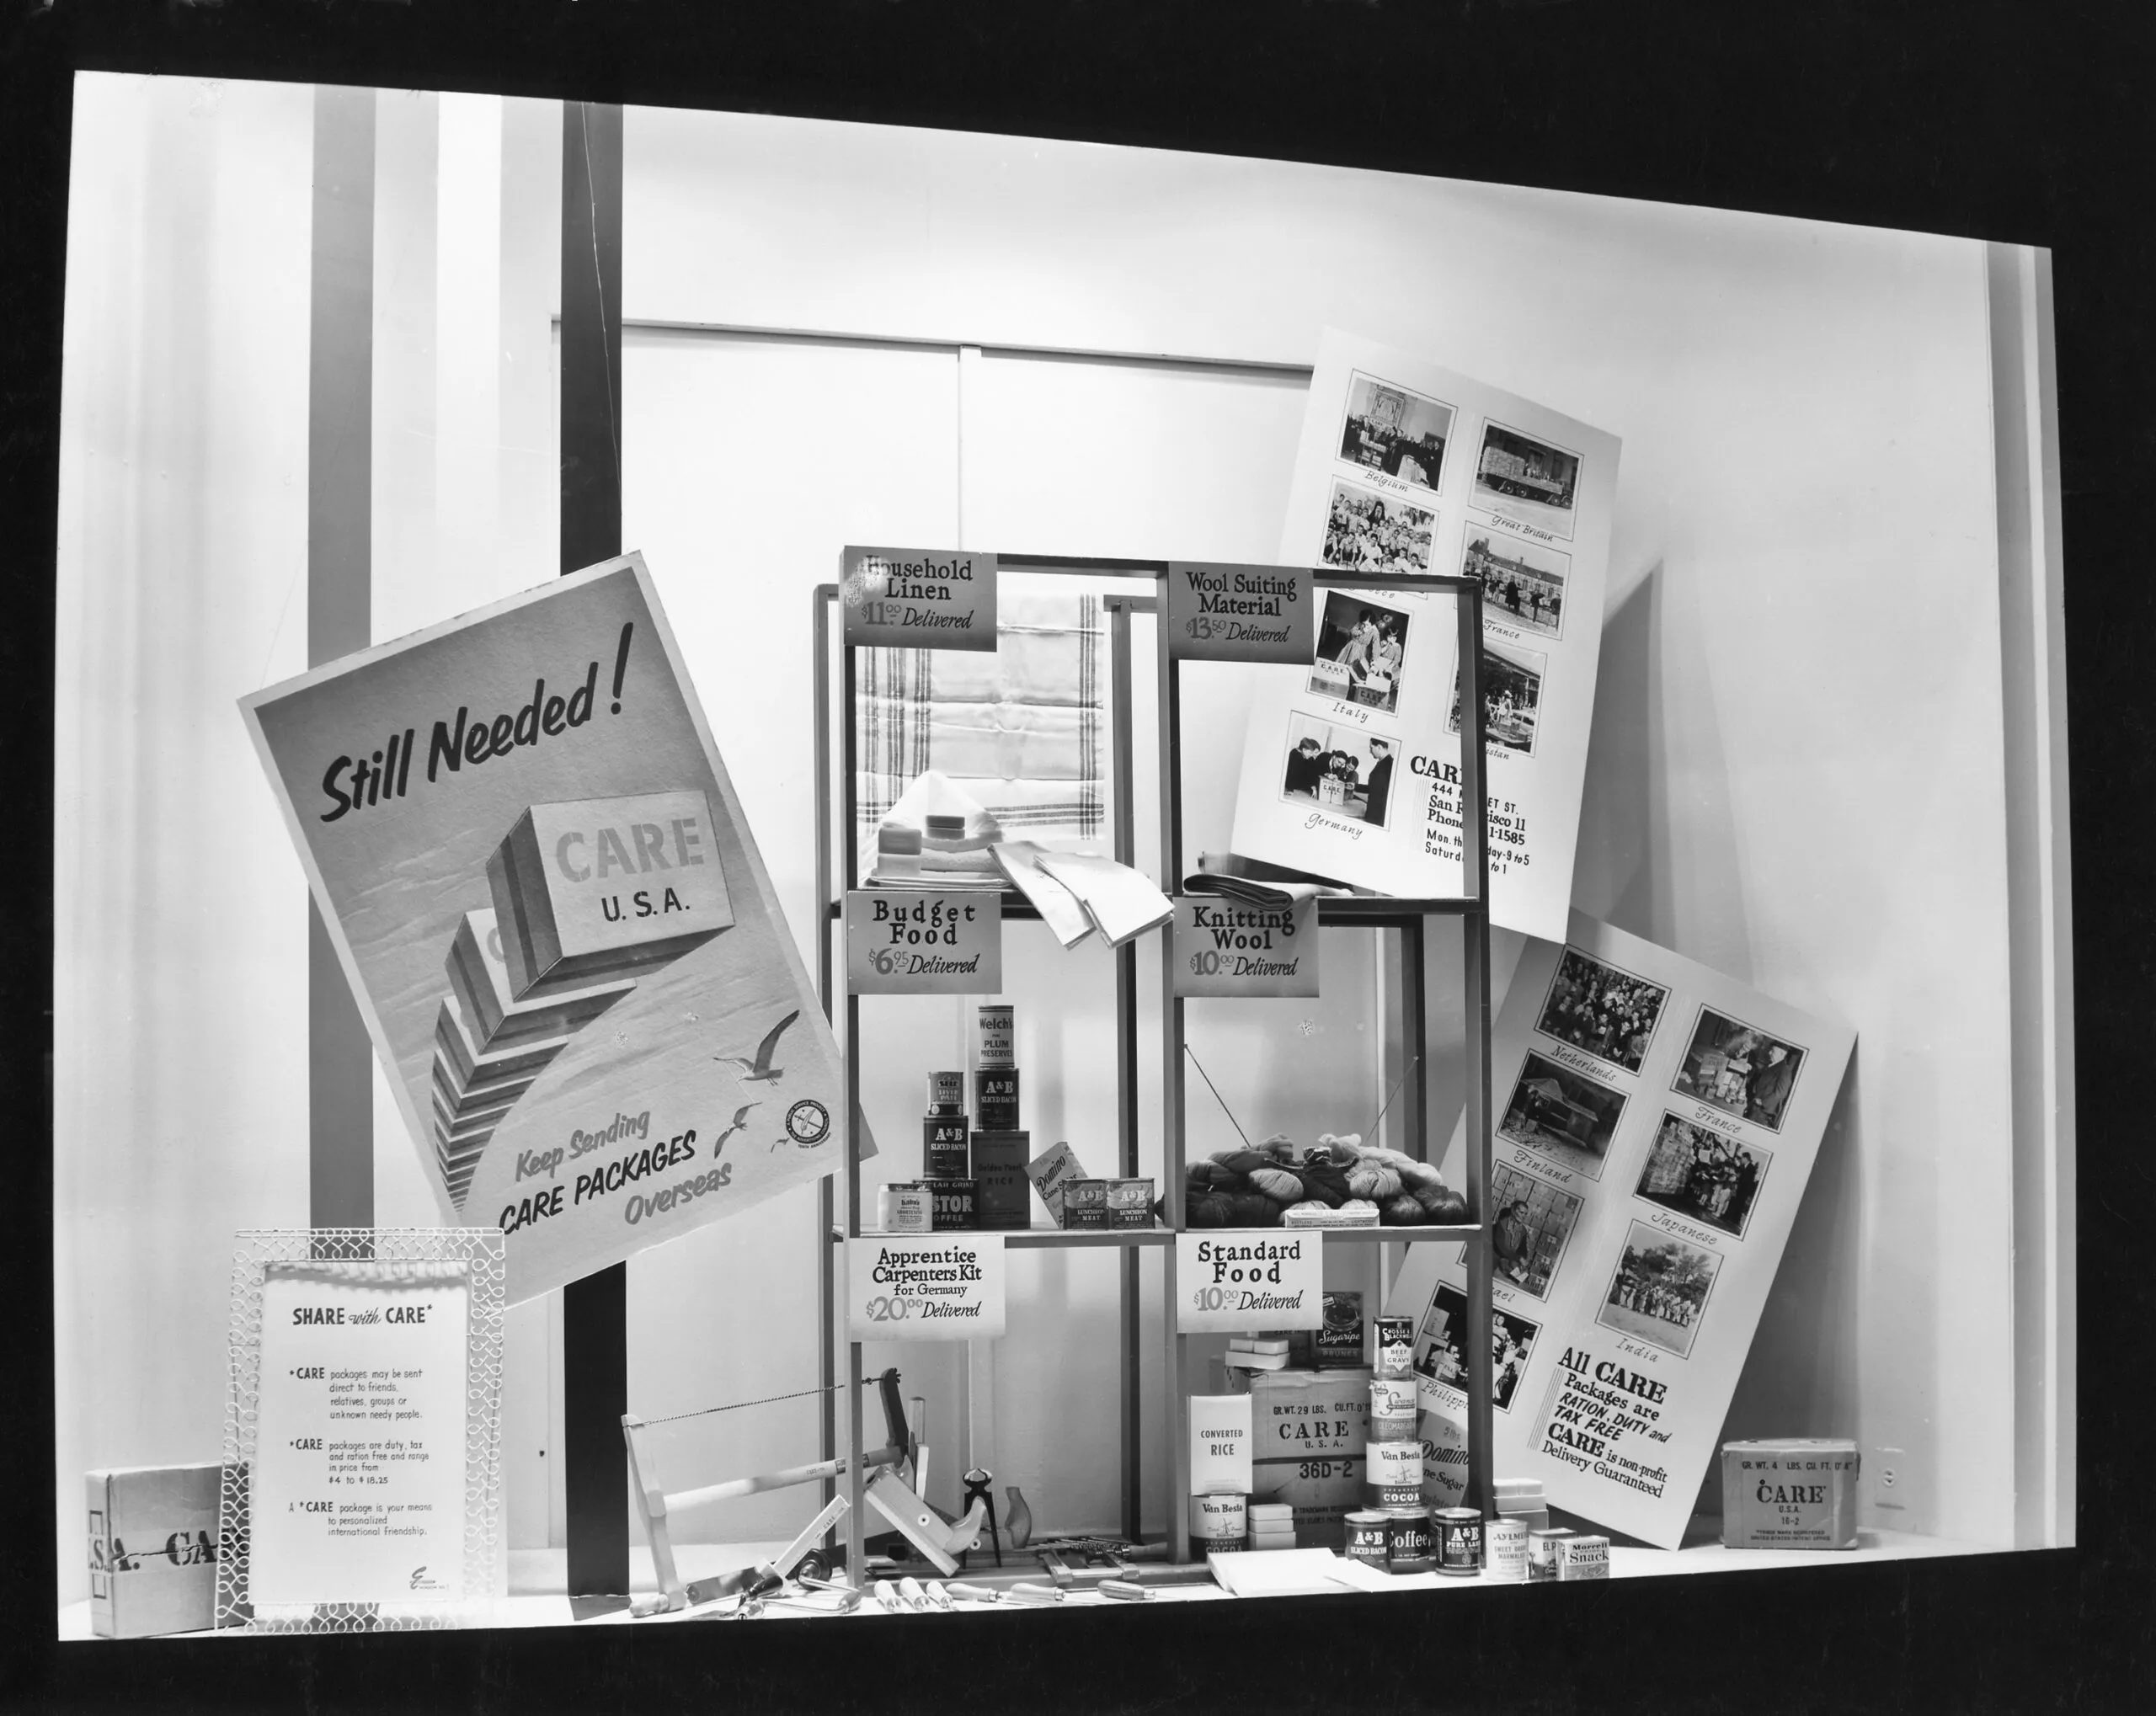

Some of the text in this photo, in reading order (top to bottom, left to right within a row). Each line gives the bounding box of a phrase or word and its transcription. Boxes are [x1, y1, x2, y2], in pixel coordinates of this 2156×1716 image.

[1364, 471, 1409, 493] Belgium
[1492, 514, 1554, 542] Great Britain
[866, 555, 974, 582] Household
[884, 578, 952, 600] Linen
[1185, 571, 1298, 603] Wool Suiting
[1198, 593, 1282, 616] Material
[901, 606, 974, 629] Delivered
[1225, 621, 1292, 643] Delivered
[1483, 620, 1520, 639] France
[1332, 702, 1369, 724] Italy
[320, 728, 414, 823] Still
[1410, 755, 1462, 786] CAR
[1432, 782, 1453, 796] 444
[1428, 795, 1453, 812] San
[1503, 802, 1519, 815] ST.
[1304, 813, 1364, 840] Germany
[555, 817, 705, 883] CARE
[1425, 841, 1464, 863] Saturd
[1491, 862, 1500, 872] to
[1427, 828, 1452, 845] Mon.
[1513, 853, 1523, 865] to
[1524, 854, 1529, 866] 5
[601, 887, 691, 922] U.S.A.
[873, 899, 976, 928] Budget
[1193, 906, 1295, 937] Knitting
[889, 923, 958, 946] Food
[1210, 929, 1273, 950] Wool
[906, 953, 980, 974] Delivered
[1232, 957, 1299, 976] Delivered
[979, 1017, 1013, 1030] Welch's
[984, 1040, 1009, 1048] PLUM
[1551, 1045, 1617, 1082] Netherlands
[985, 1080, 1013, 1094] A&B
[980, 1095, 1001, 1104] SLICED
[1694, 1106, 1742, 1134] France
[935, 1127, 963, 1142] A&B
[515, 1110, 651, 1182] Keep Sending
[930, 1143, 967, 1151] SLICED BACON
[1037, 1155, 1066, 1192] Domino
[1513, 1149, 1573, 1184] Finland
[499, 1128, 697, 1235] CARE PACKAGES
[624, 1162, 733, 1226] Overseas
[1121, 1190, 1146, 1202] A&B
[1651, 1212, 1718, 1246] Japanese
[878, 1245, 977, 1269] Apprentice
[1198, 1239, 1302, 1263] Standard
[872, 1264, 983, 1284] Carpenters Kit
[1213, 1260, 1282, 1284] Food
[894, 1282, 968, 1298] for Germany
[1236, 1289, 1304, 1310] Delivered
[292, 1307, 345, 1325] SHARE
[348, 1307, 382, 1325] with
[921, 1301, 982, 1319] Delivered
[1318, 1330, 1361, 1345] Sugaripe
[1615, 1338, 1659, 1362] India
[330, 1368, 368, 1381] packages
[371, 1371, 389, 1381] may
[392, 1368, 402, 1378] be
[403, 1368, 424, 1378] sent
[1557, 1346, 1668, 1405] All CARE
[328, 1382, 355, 1393] direct
[357, 1383, 366, 1392] to
[1421, 1380, 1468, 1411] Philipp
[1563, 1372, 1660, 1421] Packages are
[370, 1398, 396, 1410] groups
[398, 1398, 408, 1406] or
[1312, 1404, 1326, 1415] LBS.
[329, 1410, 367, 1420] unknown
[369, 1410, 392, 1422] needy
[1554, 1404, 1625, 1442] TAX FREE
[1200, 1430, 1243, 1439] CONVERTED
[1279, 1420, 1350, 1441] CARE
[1612, 1413, 1651, 1435] DUTY
[1648, 1430, 1673, 1444] and
[328, 1441, 366, 1452] packages
[369, 1442, 382, 1450] are
[409, 1440, 423, 1449] tax
[1210, 1443, 1235, 1456] RICE
[1381, 1451, 1398, 1461] Van
[1547, 1422, 1668, 1484] CARE is non-profit
[328, 1451, 430, 1463] and ration free and range
[1786, 1462, 1832, 1471] LBS. FT.
[328, 1462, 379, 1474] in price from
[1299, 1460, 1353, 1479] 36D-2
[1541, 1440, 1664, 1499] Delivery Guaranteed
[328, 1476, 341, 1484] $4
[346, 1476, 355, 1484] to
[1436, 1470, 1465, 1492] Sugar
[1383, 1493, 1420, 1502] COCOA
[289, 1502, 295, 1512] A
[339, 1503, 373, 1516] package
[376, 1502, 383, 1512] is
[387, 1504, 404, 1515] your
[408, 1503, 432, 1512] means
[1202, 1503, 1220, 1514] Van
[1778, 1505, 1802, 1514] U.S.A.
[328, 1516, 387, 1527] to personalized
[1781, 1516, 1801, 1526] 16-2
[328, 1527, 381, 1537] international
[1354, 1531, 1385, 1545] A&B
[1451, 1527, 1479, 1542] A&B
[1350, 1547, 1370, 1555] SLICED
[1370, 1547, 1387, 1555] BACON
[1572, 1543, 1608, 1551] Morrell
[1569, 1553, 1609, 1564] Snack
